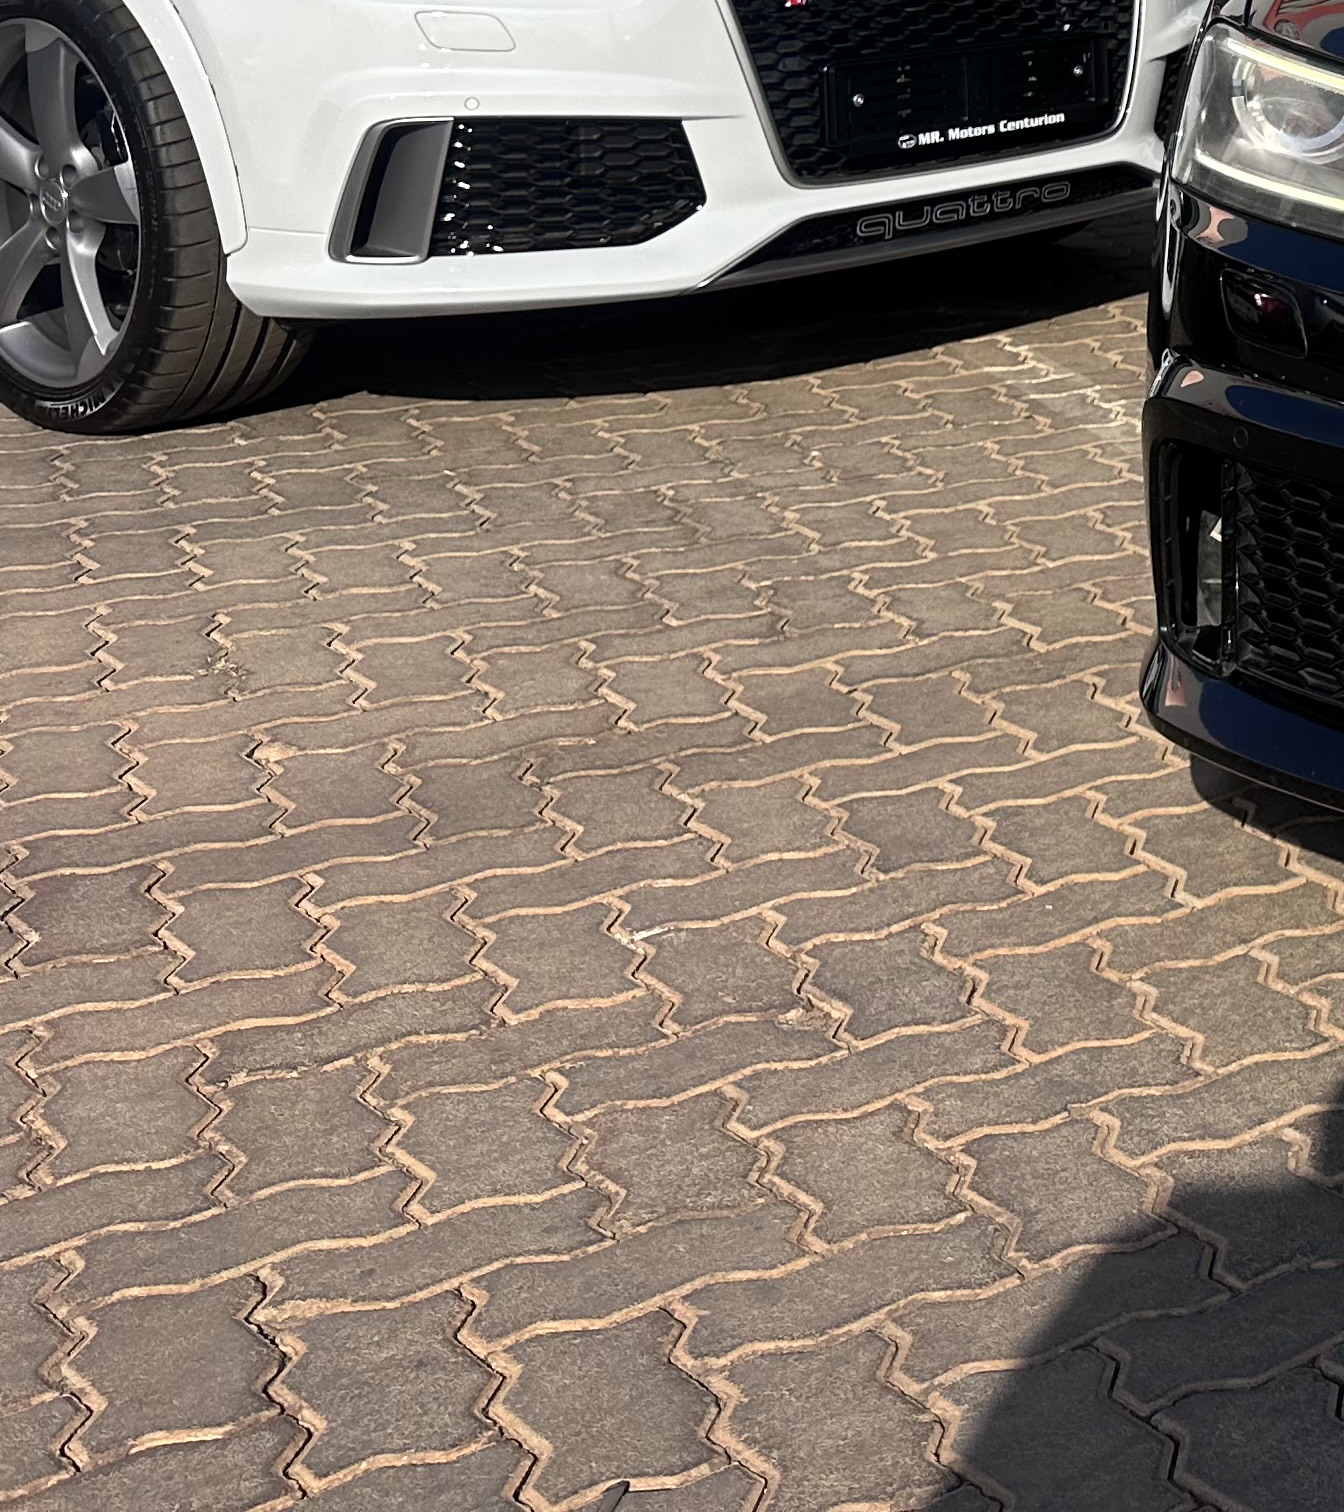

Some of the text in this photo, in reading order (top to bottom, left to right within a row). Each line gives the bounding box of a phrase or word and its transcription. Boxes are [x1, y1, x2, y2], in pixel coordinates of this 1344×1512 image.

[918, 110, 1065, 146] MR. Motors Centurion
[857, 182, 1071, 239] quattro
